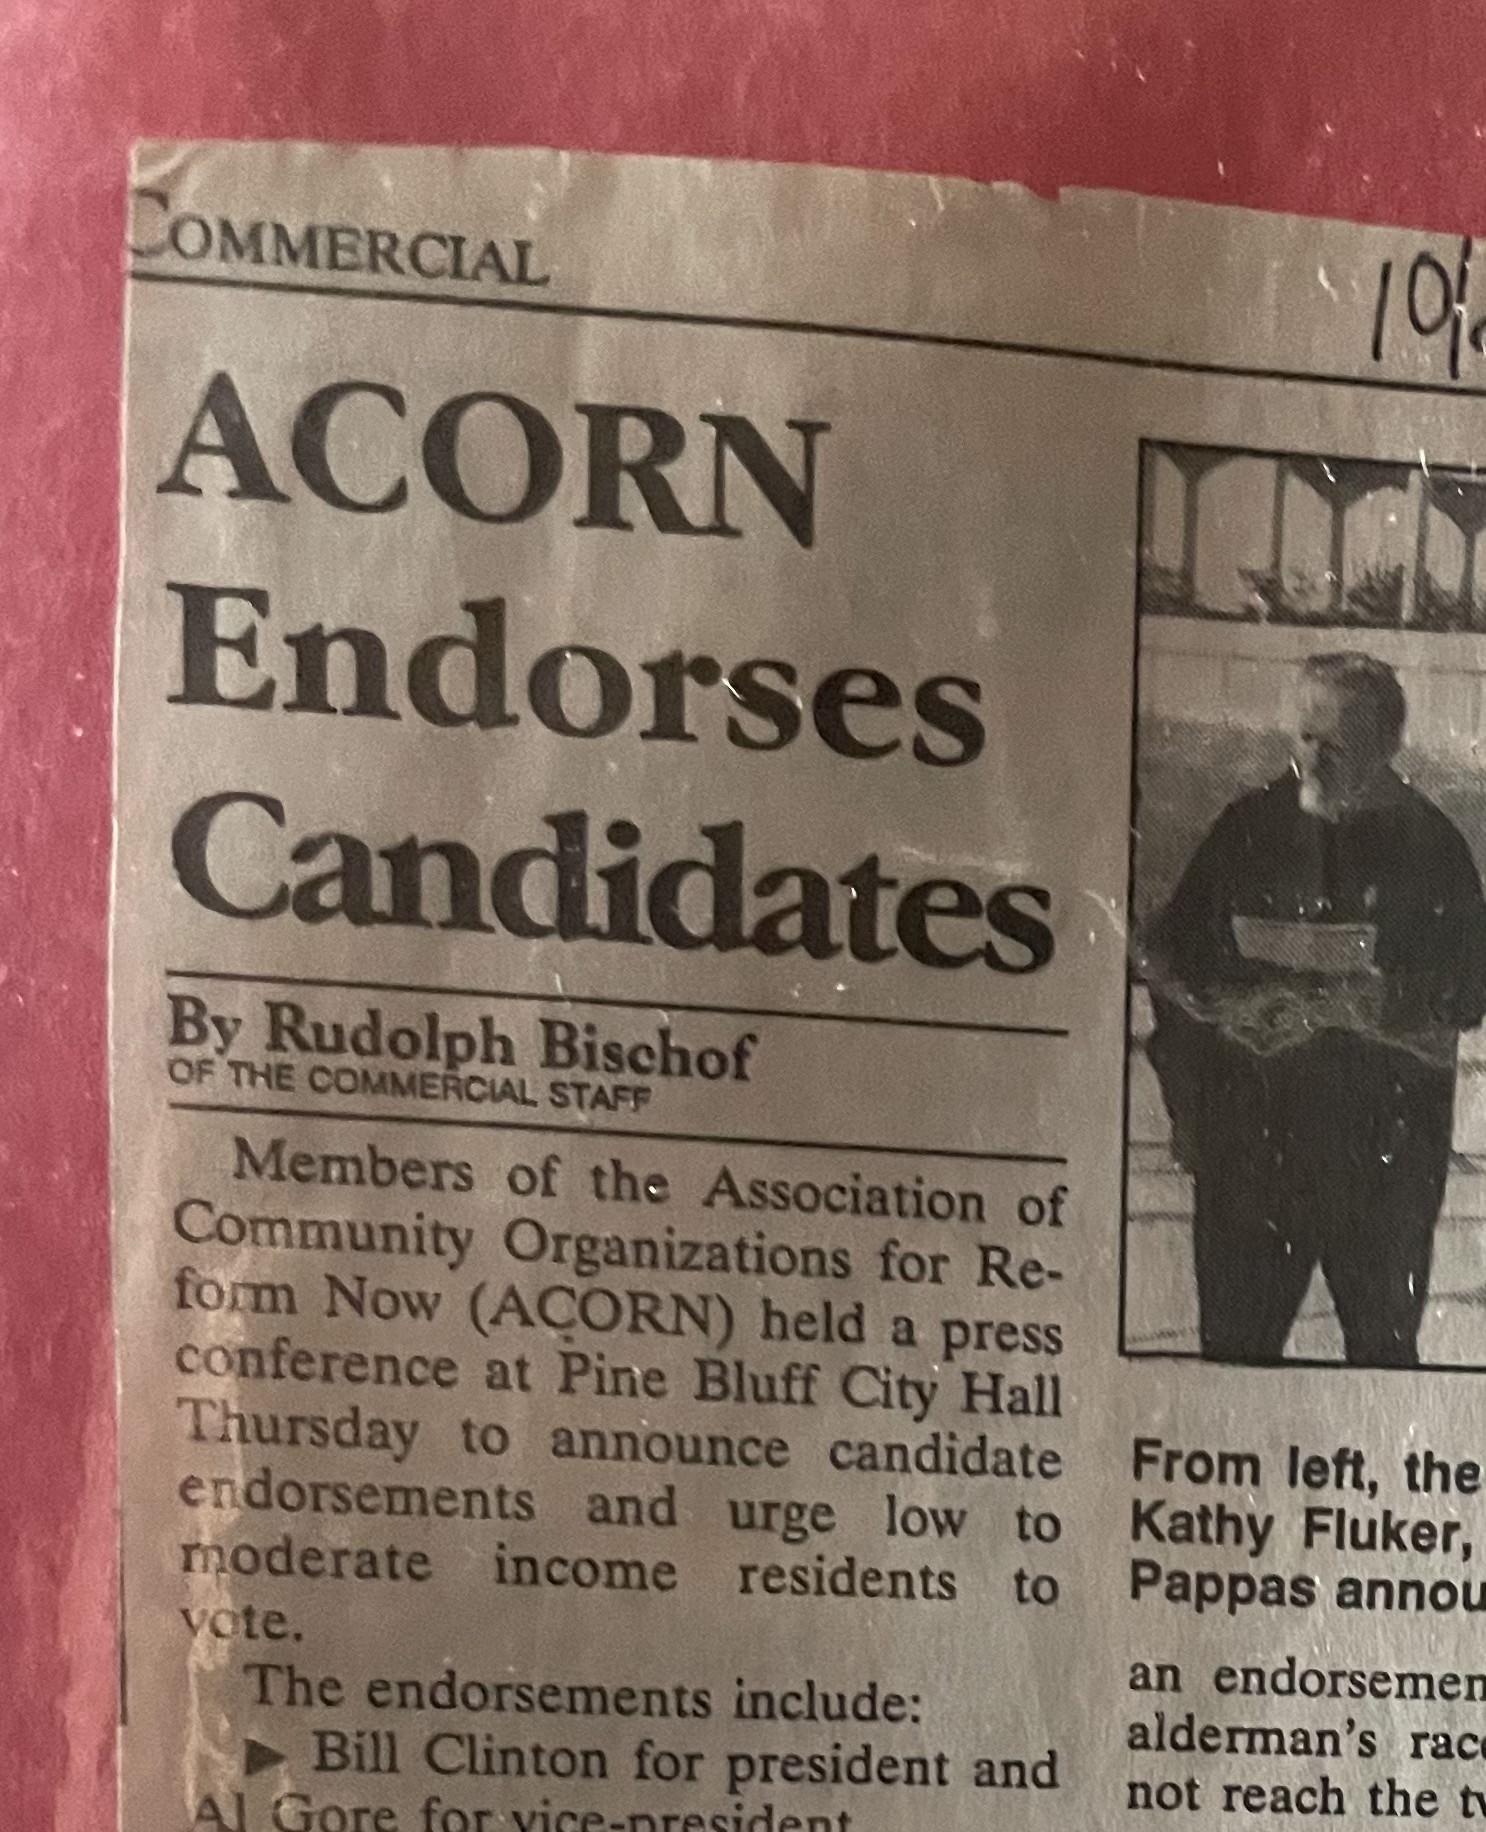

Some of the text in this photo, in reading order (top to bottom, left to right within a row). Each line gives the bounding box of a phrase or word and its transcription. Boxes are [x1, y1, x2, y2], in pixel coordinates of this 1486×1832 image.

[156, 370, 832, 549] ACORN
[166, 582, 987, 768] Endorses
[171, 791, 1057, 974] Candidates
[167, 993, 759, 1083] By Rudolph Bischof
[166, 1055, 651, 1114] OF THE COMMERCIAL STAFF
[233, 1134, 1069, 1229] Members of the Association of
[173, 1196, 1063, 1292] Community Organizations for Re-
[174, 1335, 1062, 1424] conference at Pine Bluff City Hall
[1133, 1437, 1261, 1489] From
[1288, 1444, 1378, 1501] left,
[1404, 1449, 1481, 1497] the
[1131, 1498, 1275, 1559] Kathy
[1303, 1505, 1472, 1563] Fluker,
[1130, 1558, 1316, 1617] Pappas
[242, 1661, 921, 1725] The endorsements include:
[1128, 1661, 1183, 1694] an
[312, 1729, 1060, 1797] Bill Clinton for president and
[1127, 1776, 1201, 1812] not
[1222, 1774, 1346, 1817] reach
[1368, 1775, 1439, 1819] the
